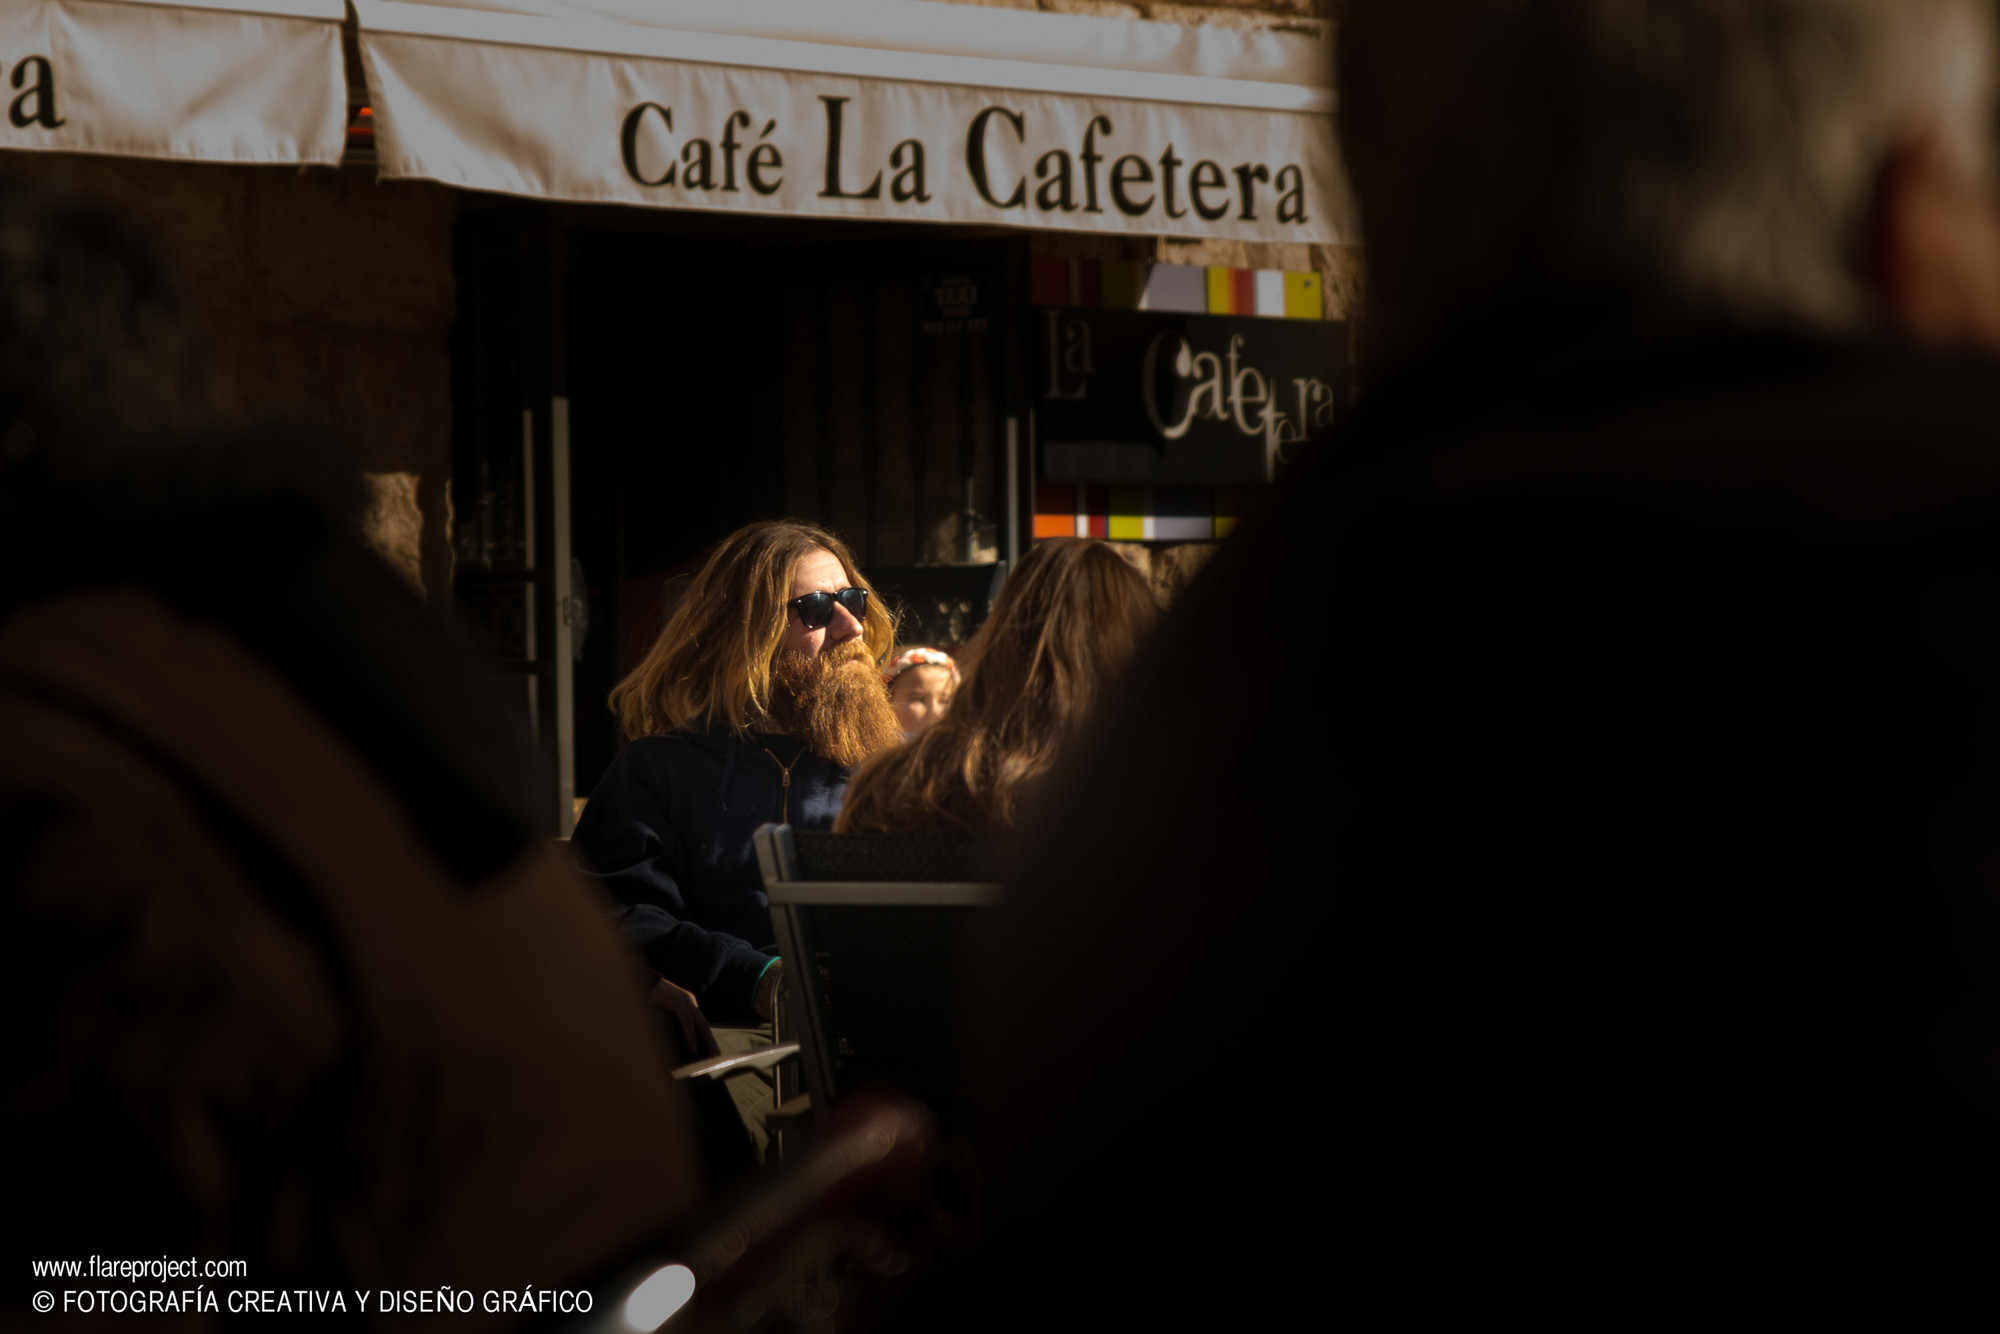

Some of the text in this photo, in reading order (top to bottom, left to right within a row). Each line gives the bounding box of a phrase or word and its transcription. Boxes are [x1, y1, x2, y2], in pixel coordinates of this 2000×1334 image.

[0, 54, 66, 129] a
[620, 94, 1309, 225] Café La Cafetera
[933, 285, 977, 307] TAXI
[1043, 308, 1335, 483] La Cafetera
